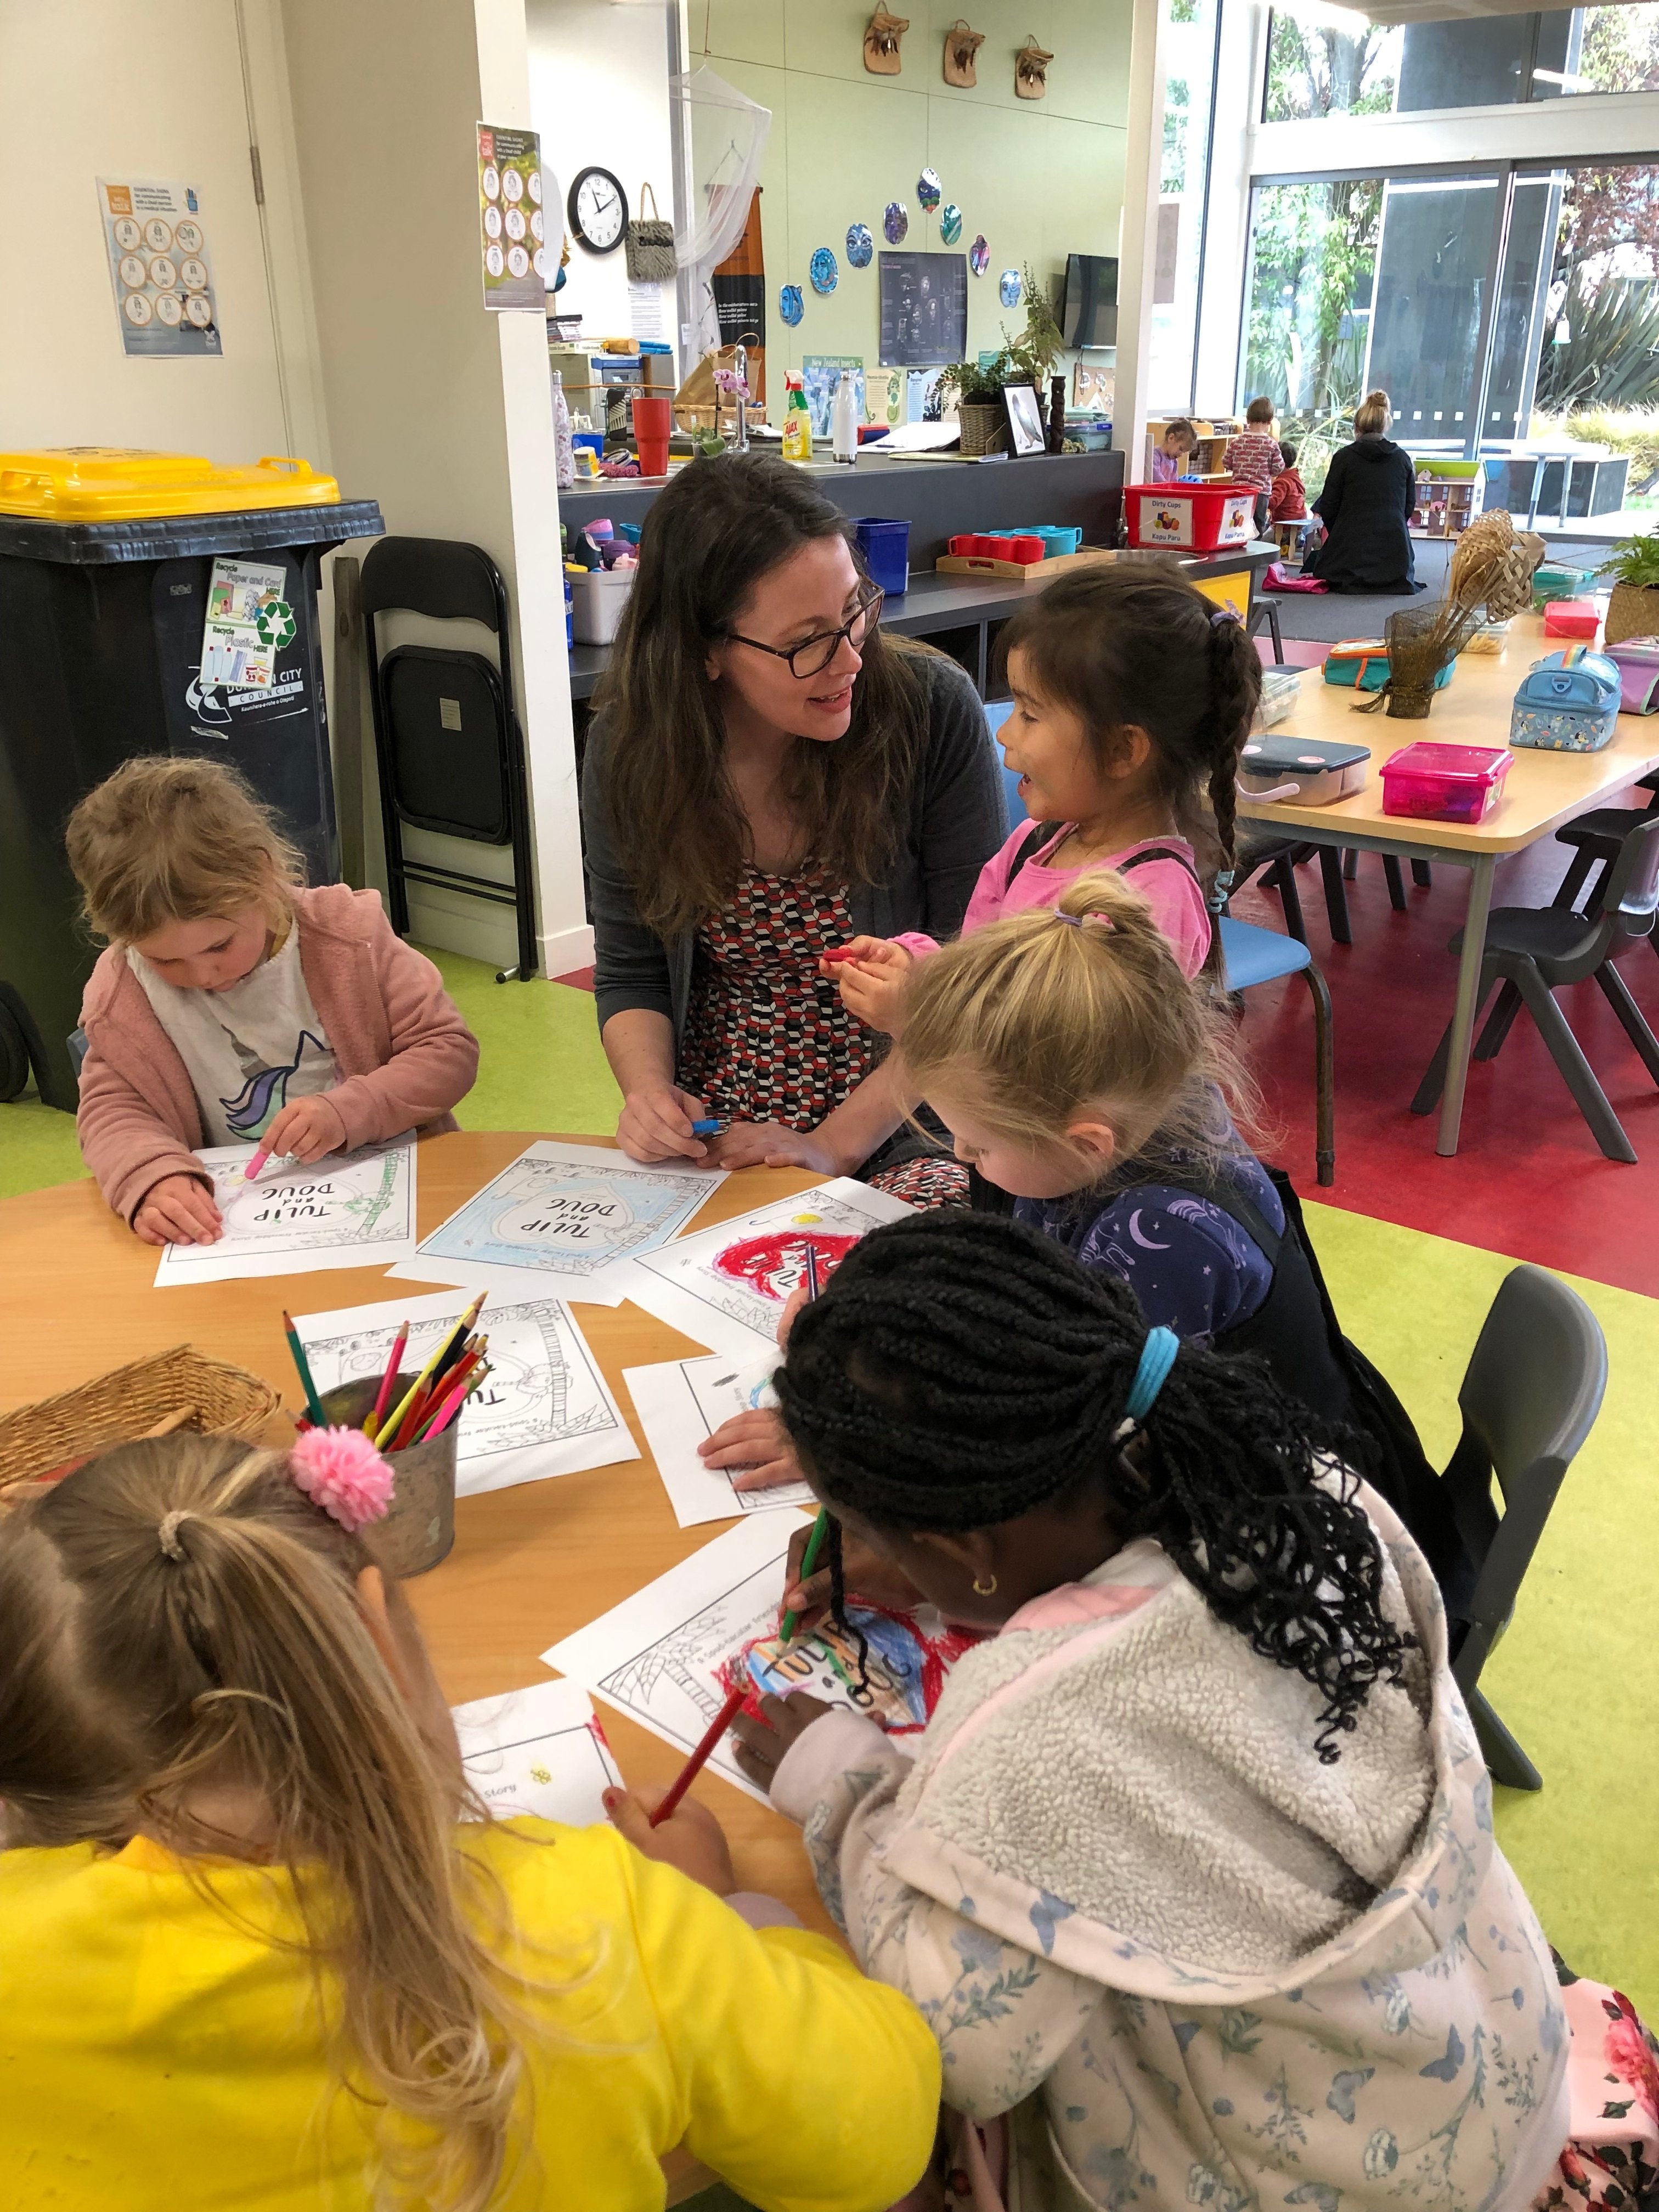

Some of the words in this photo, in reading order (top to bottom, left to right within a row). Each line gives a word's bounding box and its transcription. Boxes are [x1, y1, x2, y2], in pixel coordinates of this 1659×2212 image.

[812, 358, 822, 366] New
[823, 357, 840, 367] Zealand
[840, 358, 856, 368] Insects
[785, 420, 798, 435] AJAX
[1152, 500, 1166, 509] Dirty
[1167, 500, 1181, 509] Cups
[1152, 532, 1167, 541] Kapu
[216, 562, 238, 573] Recycle
[227, 572, 249, 584] Paper
[249, 576, 264, 585] and
[265, 577, 282, 588] Card
[266, 586, 281, 596] HERE
[212, 625, 235, 636] Recycle
[225, 635, 254, 649] Plastic
[253, 645, 268, 653] HERE
[280, 668, 302, 682] CITY
[240, 687, 294, 703] COUNCIL
[282, 1197, 315, 1206] and
[253, 1205, 331, 1221] TULIP
[555, 1212, 590, 1222] and
[520, 1219, 591, 1238] TULIP
[741, 1256, 800, 1288] TULIP
[483, 1782, 517, 1799] Story
